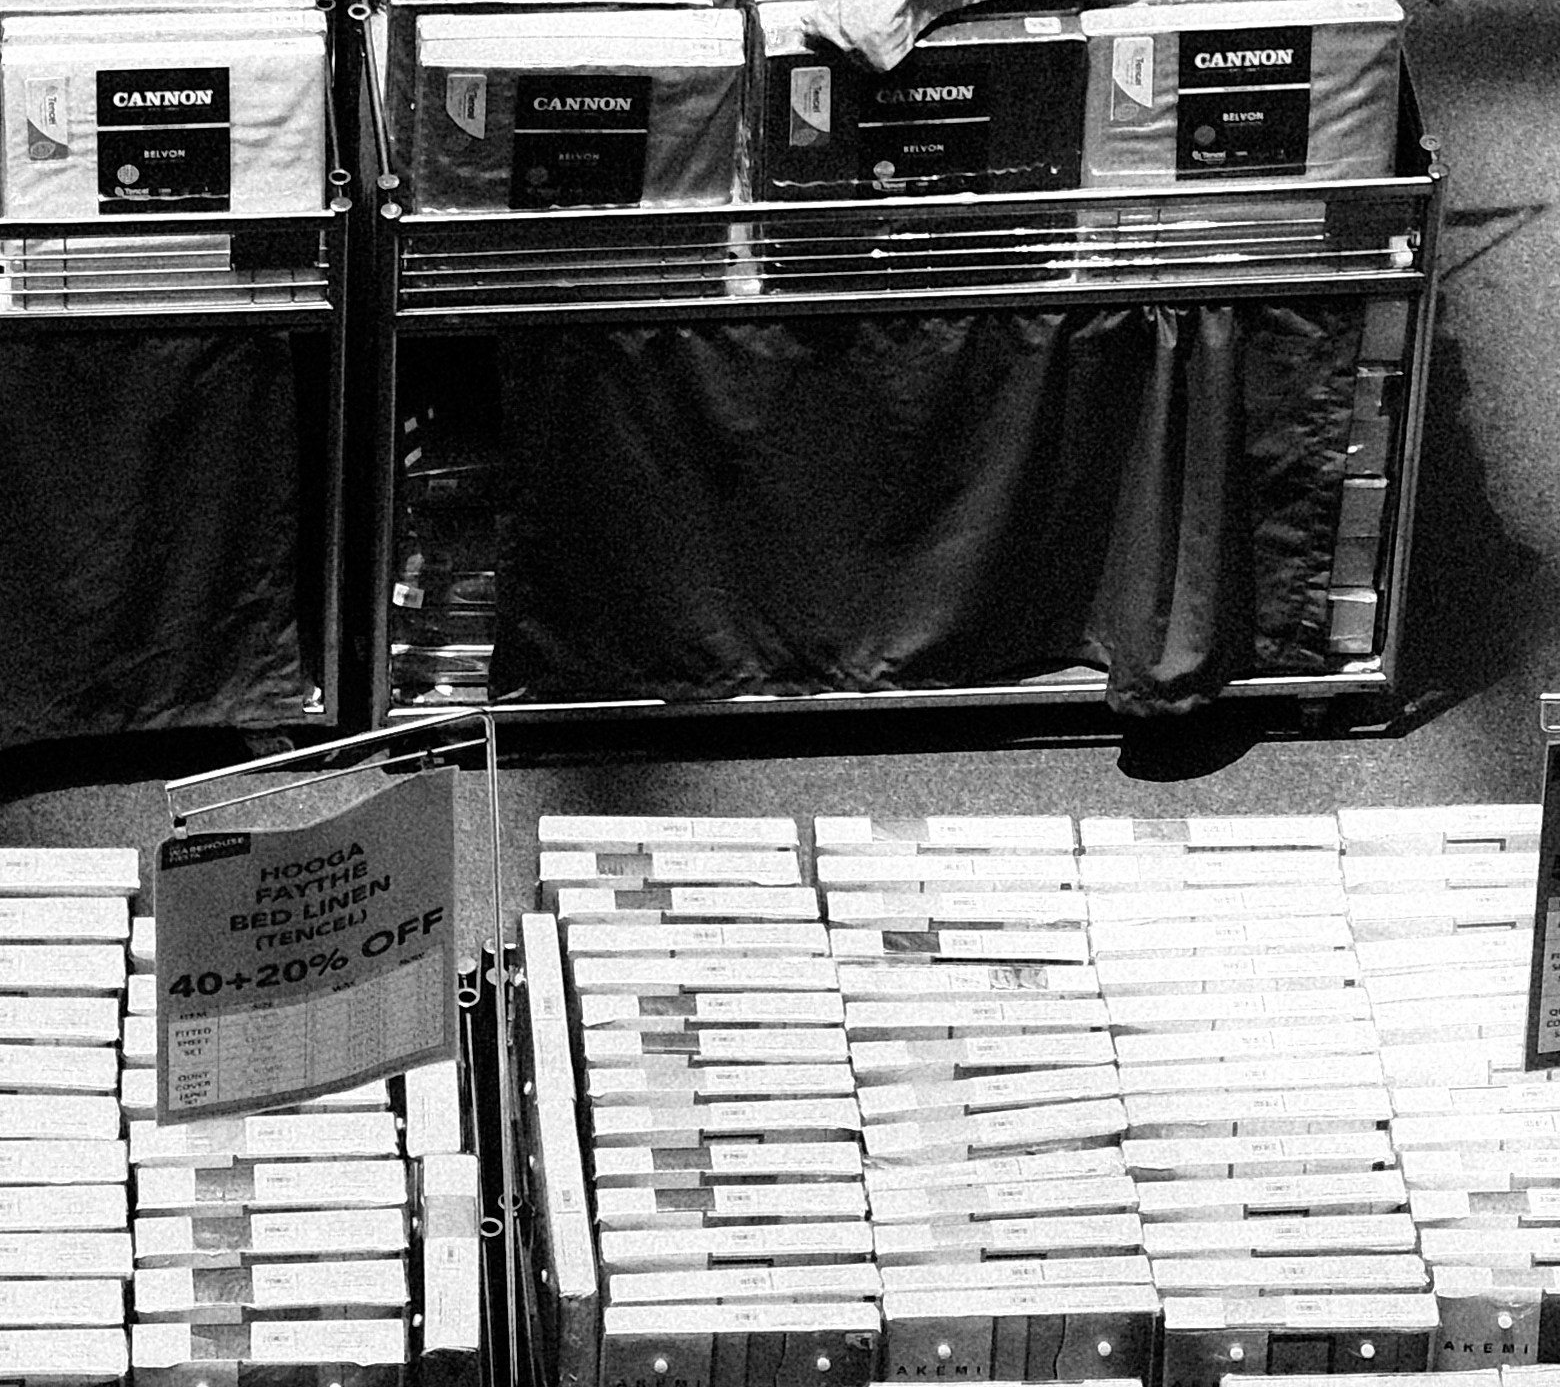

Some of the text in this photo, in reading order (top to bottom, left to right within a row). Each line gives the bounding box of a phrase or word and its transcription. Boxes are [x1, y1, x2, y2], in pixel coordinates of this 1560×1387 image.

[1194, 49, 1294, 68] CANNON
[113, 89, 213, 107] CANNON
[876, 85, 975, 103] CANNON
[46, 96, 57, 126] Tencel
[533, 97, 633, 111] CANNON
[1222, 112, 1264, 121] BELVON
[144, 150, 185, 158] BELVON
[903, 144, 944, 153] BELVON
[261, 842, 364, 882] HOOGA
[256, 860, 368, 904] FAYTHE
[230, 874, 391, 931] BED LINEN
[256, 908, 368, 951] (TENCEL)
[169, 907, 444, 998] 40+20% OFF
[1443, 1340, 1529, 1355] AKEMI
